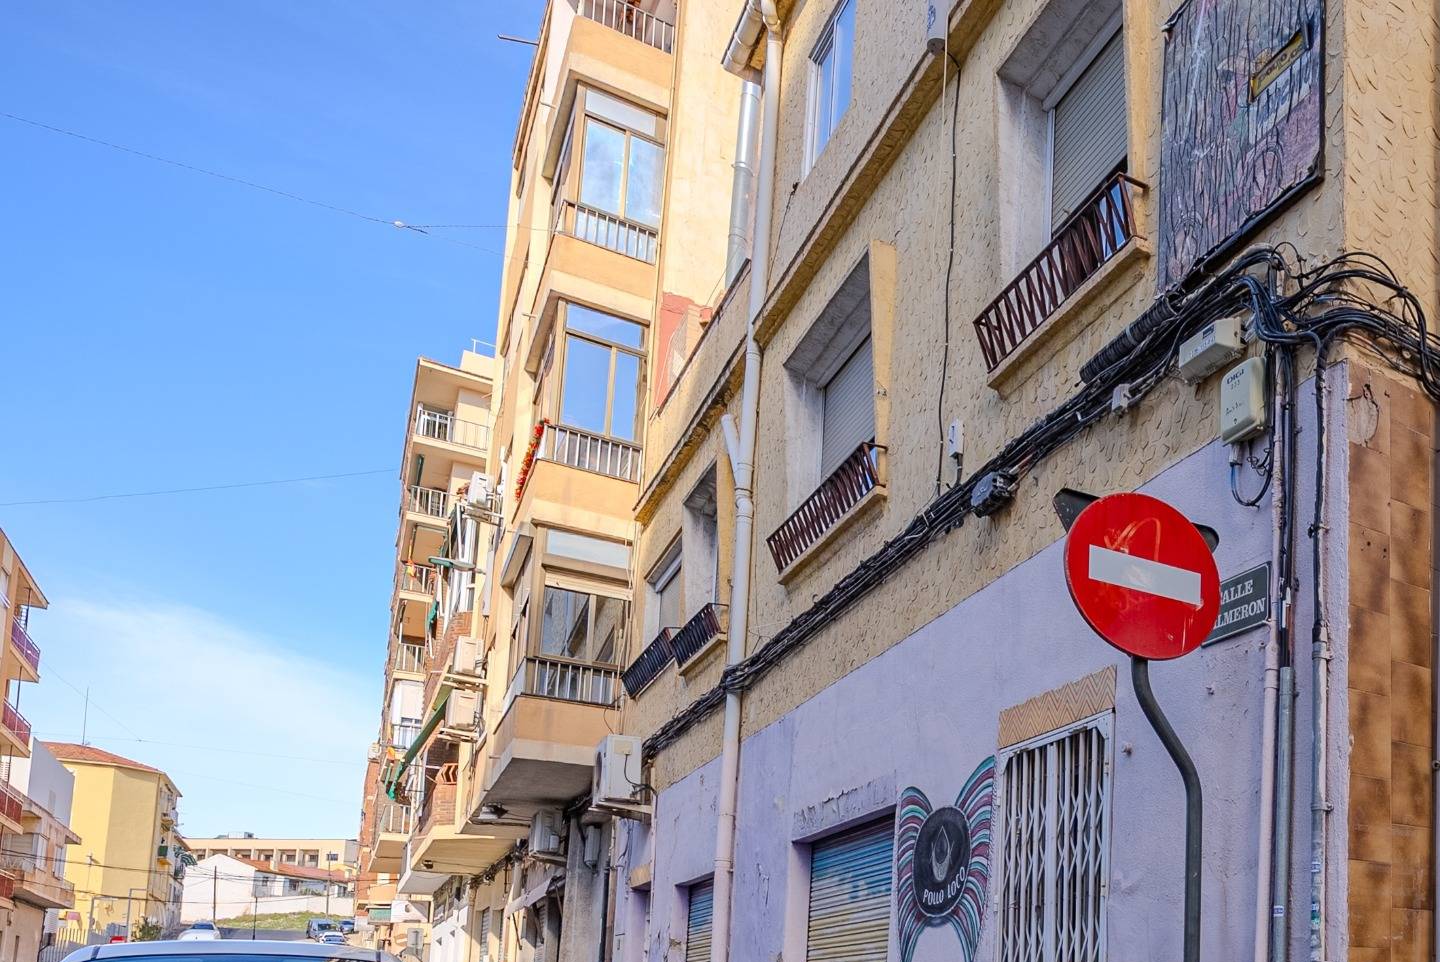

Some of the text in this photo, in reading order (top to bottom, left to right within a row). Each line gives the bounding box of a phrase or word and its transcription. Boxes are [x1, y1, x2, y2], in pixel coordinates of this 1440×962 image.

[1221, 580, 1254, 605] ALLE
[1214, 597, 1266, 630] LMERON
[923, 866, 966, 906] POLLO LOCO
